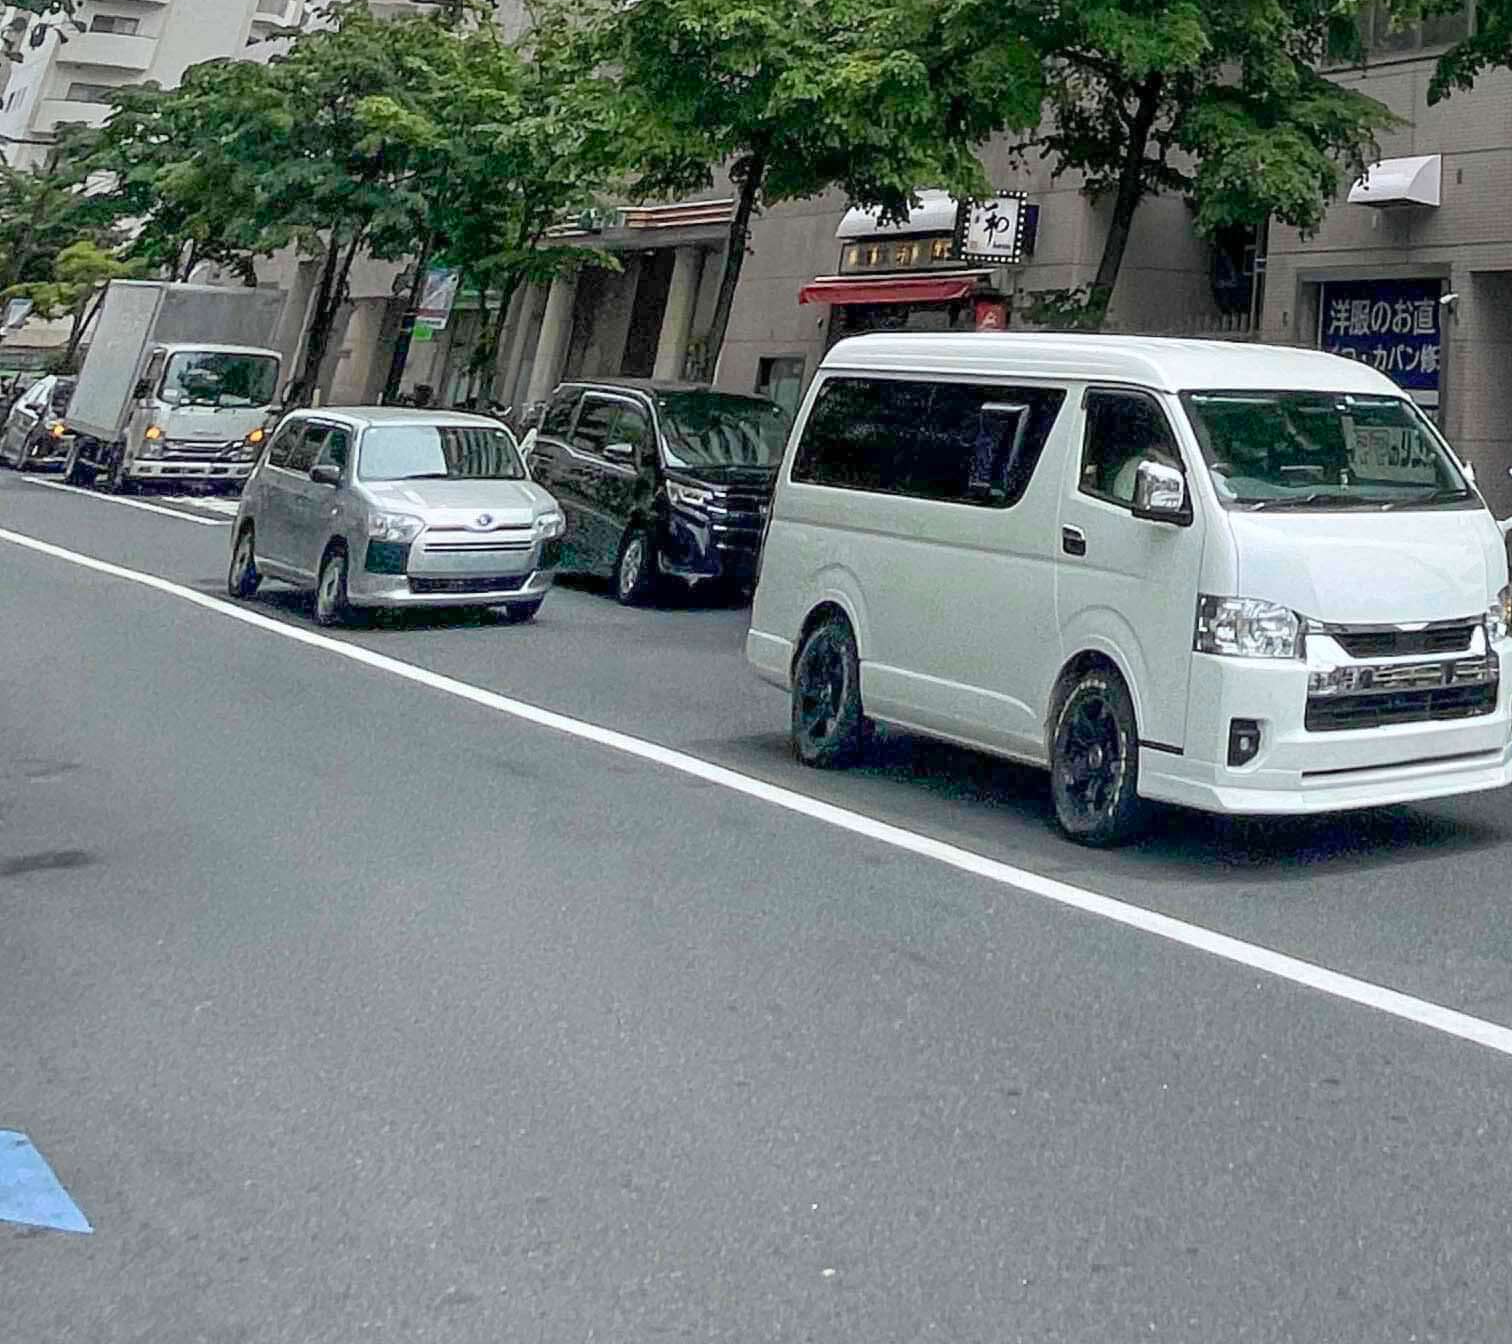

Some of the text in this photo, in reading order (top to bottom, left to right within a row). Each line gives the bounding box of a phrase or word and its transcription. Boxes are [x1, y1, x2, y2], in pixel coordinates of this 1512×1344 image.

[1328, 298, 1440, 335] 洋服のお直
